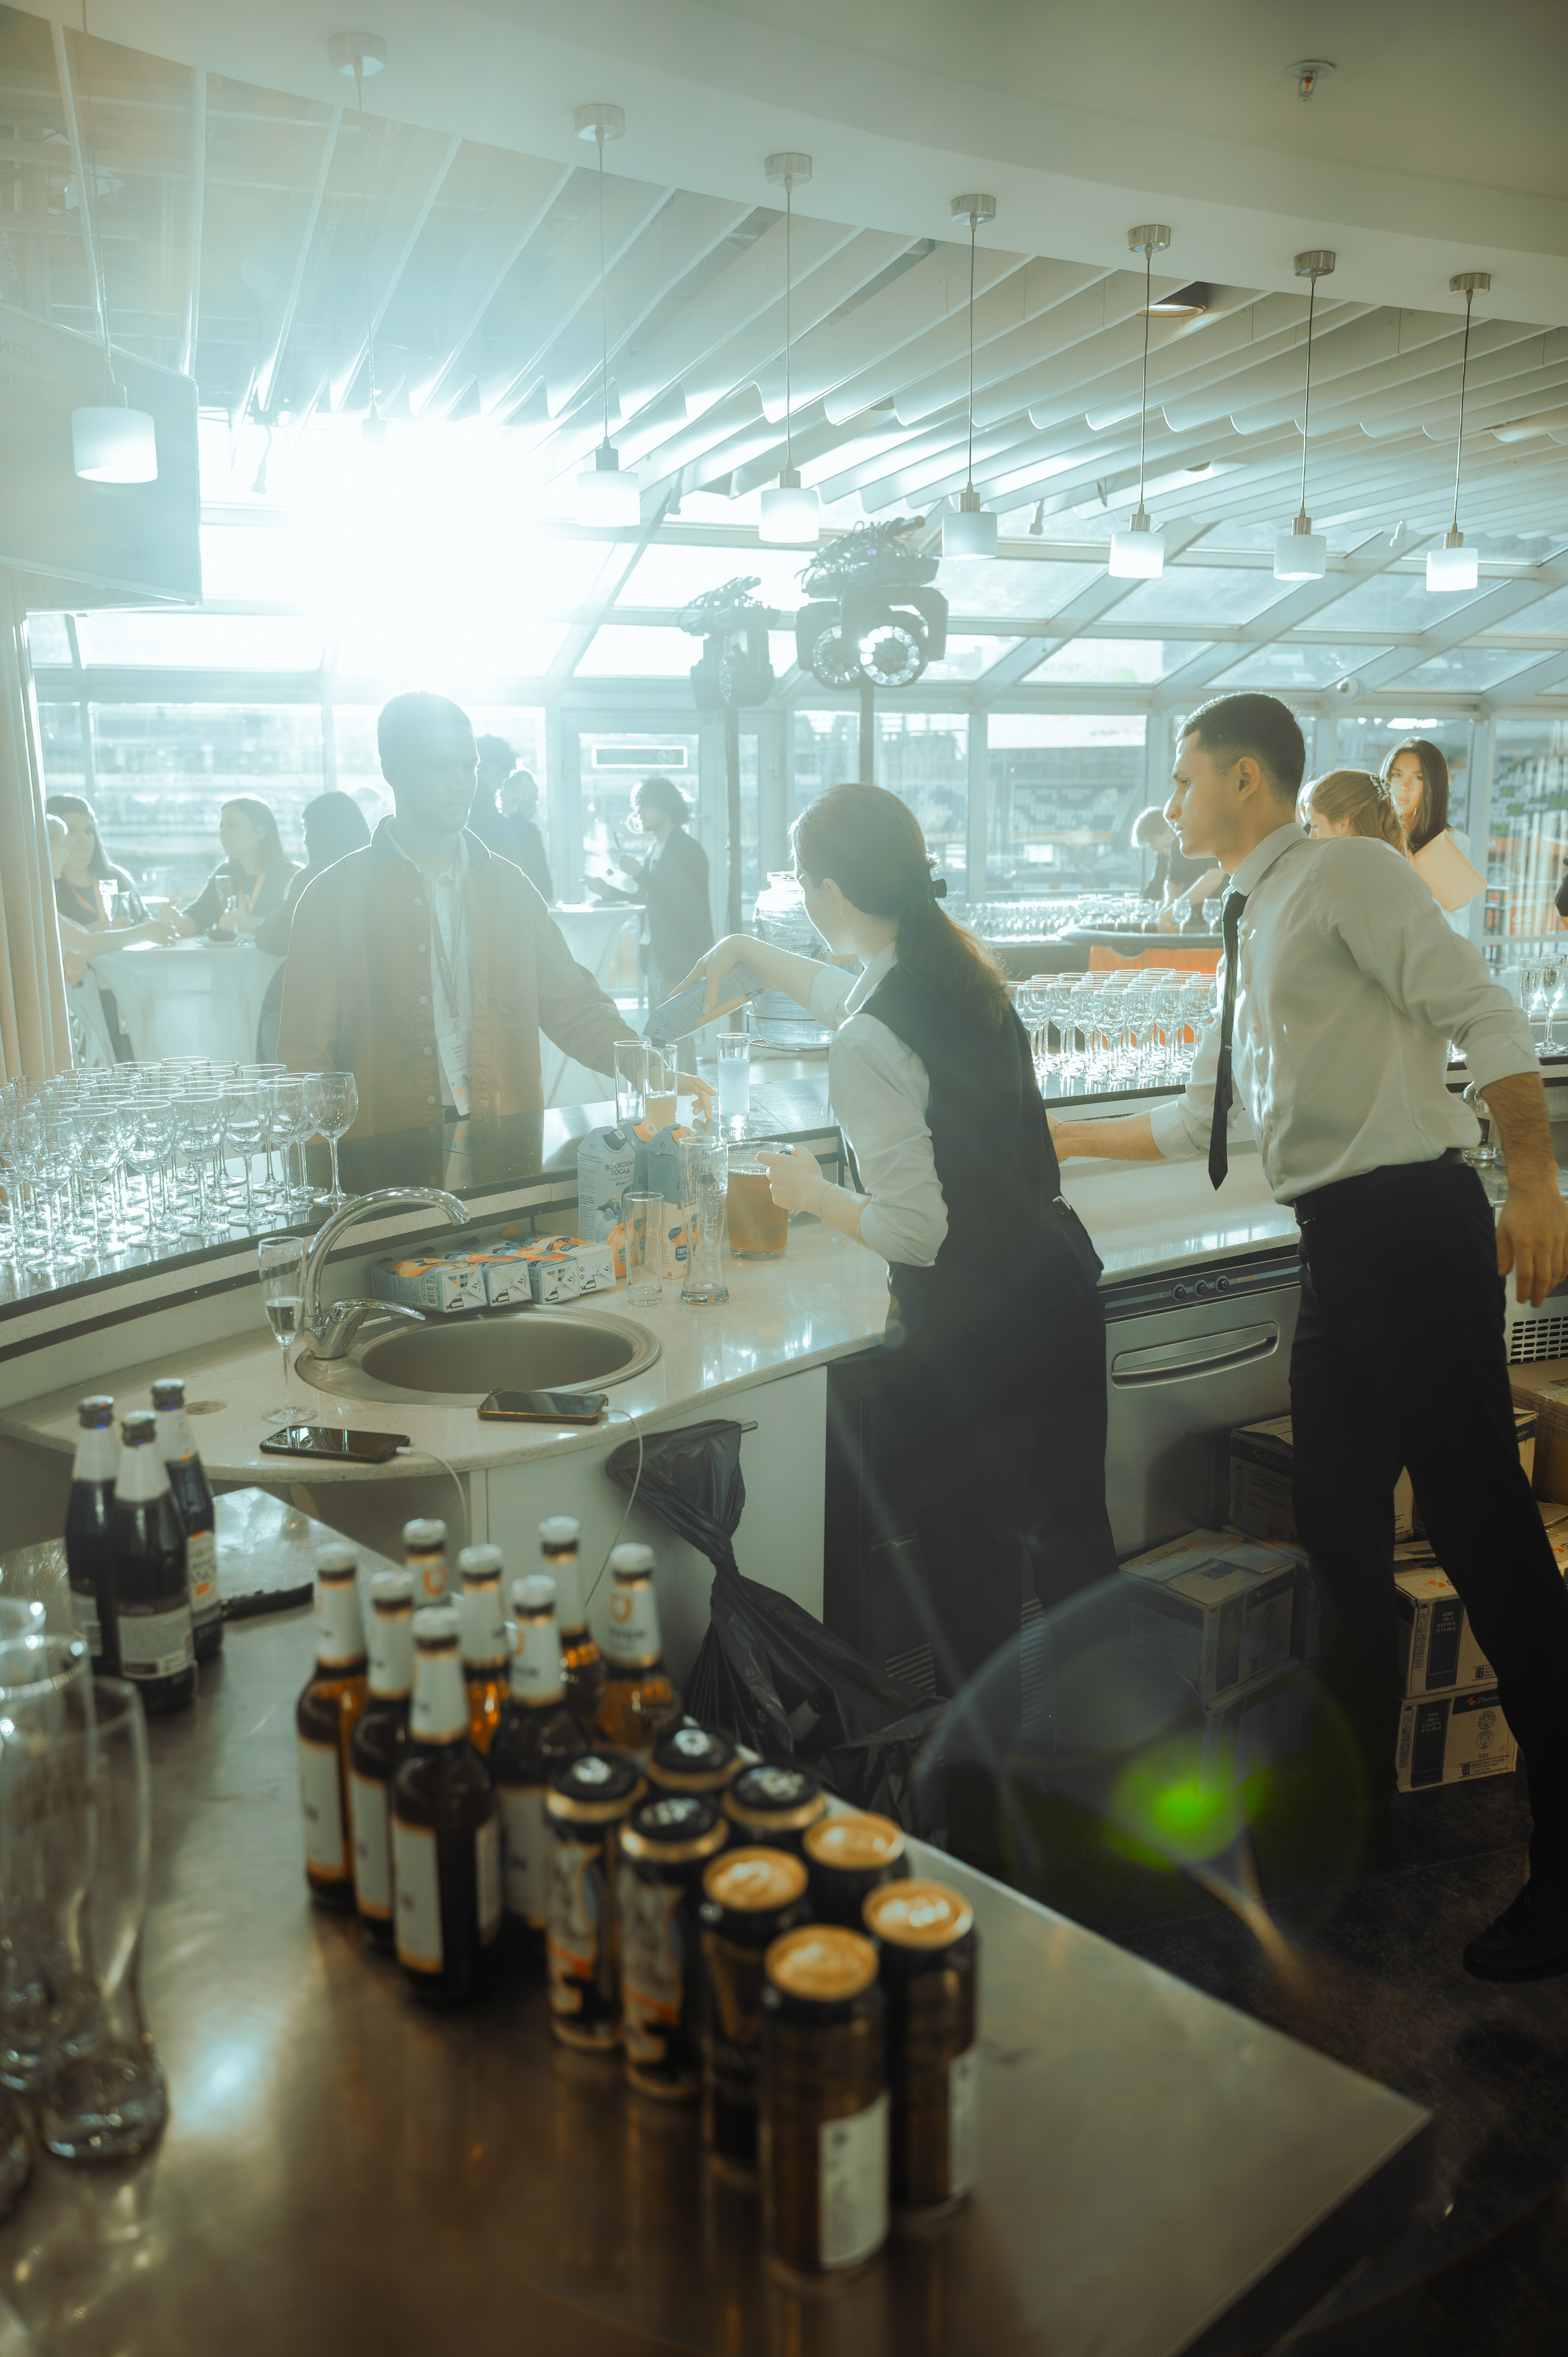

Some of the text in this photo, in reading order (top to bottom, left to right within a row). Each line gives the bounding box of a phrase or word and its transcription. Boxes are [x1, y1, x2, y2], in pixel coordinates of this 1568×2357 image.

[0, 334, 33, 364] ига
[0, 365, 47, 397] вито
[605, 1158, 634, 1171] ВОЛЖСКИЙ
[611, 1167, 630, 1176] ПОСАД
